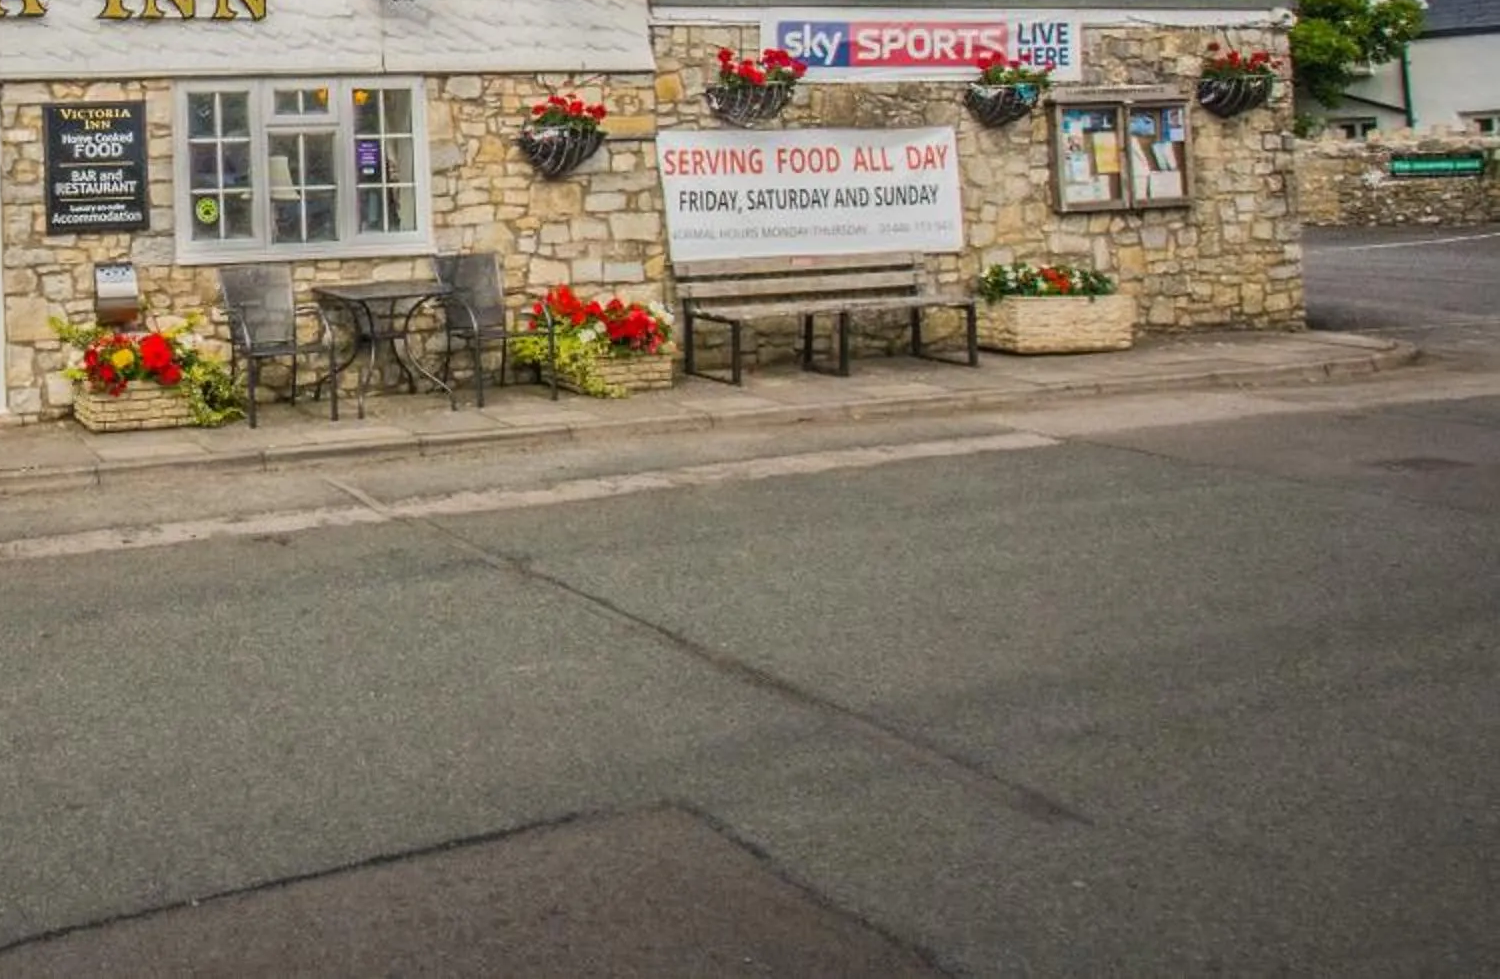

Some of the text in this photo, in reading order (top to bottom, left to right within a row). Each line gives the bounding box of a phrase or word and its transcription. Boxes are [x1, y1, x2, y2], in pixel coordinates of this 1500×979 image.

[1017, 22, 1069, 44] LIVE
[784, 24, 1005, 66] sky SPORTS
[1017, 47, 1069, 66] HERE
[60, 108, 132, 120] VICTORIA
[84, 119, 112, 130] INN
[61, 131, 134, 145] Home Cooked
[73, 142, 124, 158] FOOD
[664, 145, 949, 176] SERVING FOOD ALL DAY
[71, 169, 123, 182] BAR and
[55, 180, 138, 196] RESTAURANT
[679, 184, 940, 215] FRIDAY, SATURDAY AND SUNDAY
[52, 210, 143, 224] Accommodation
